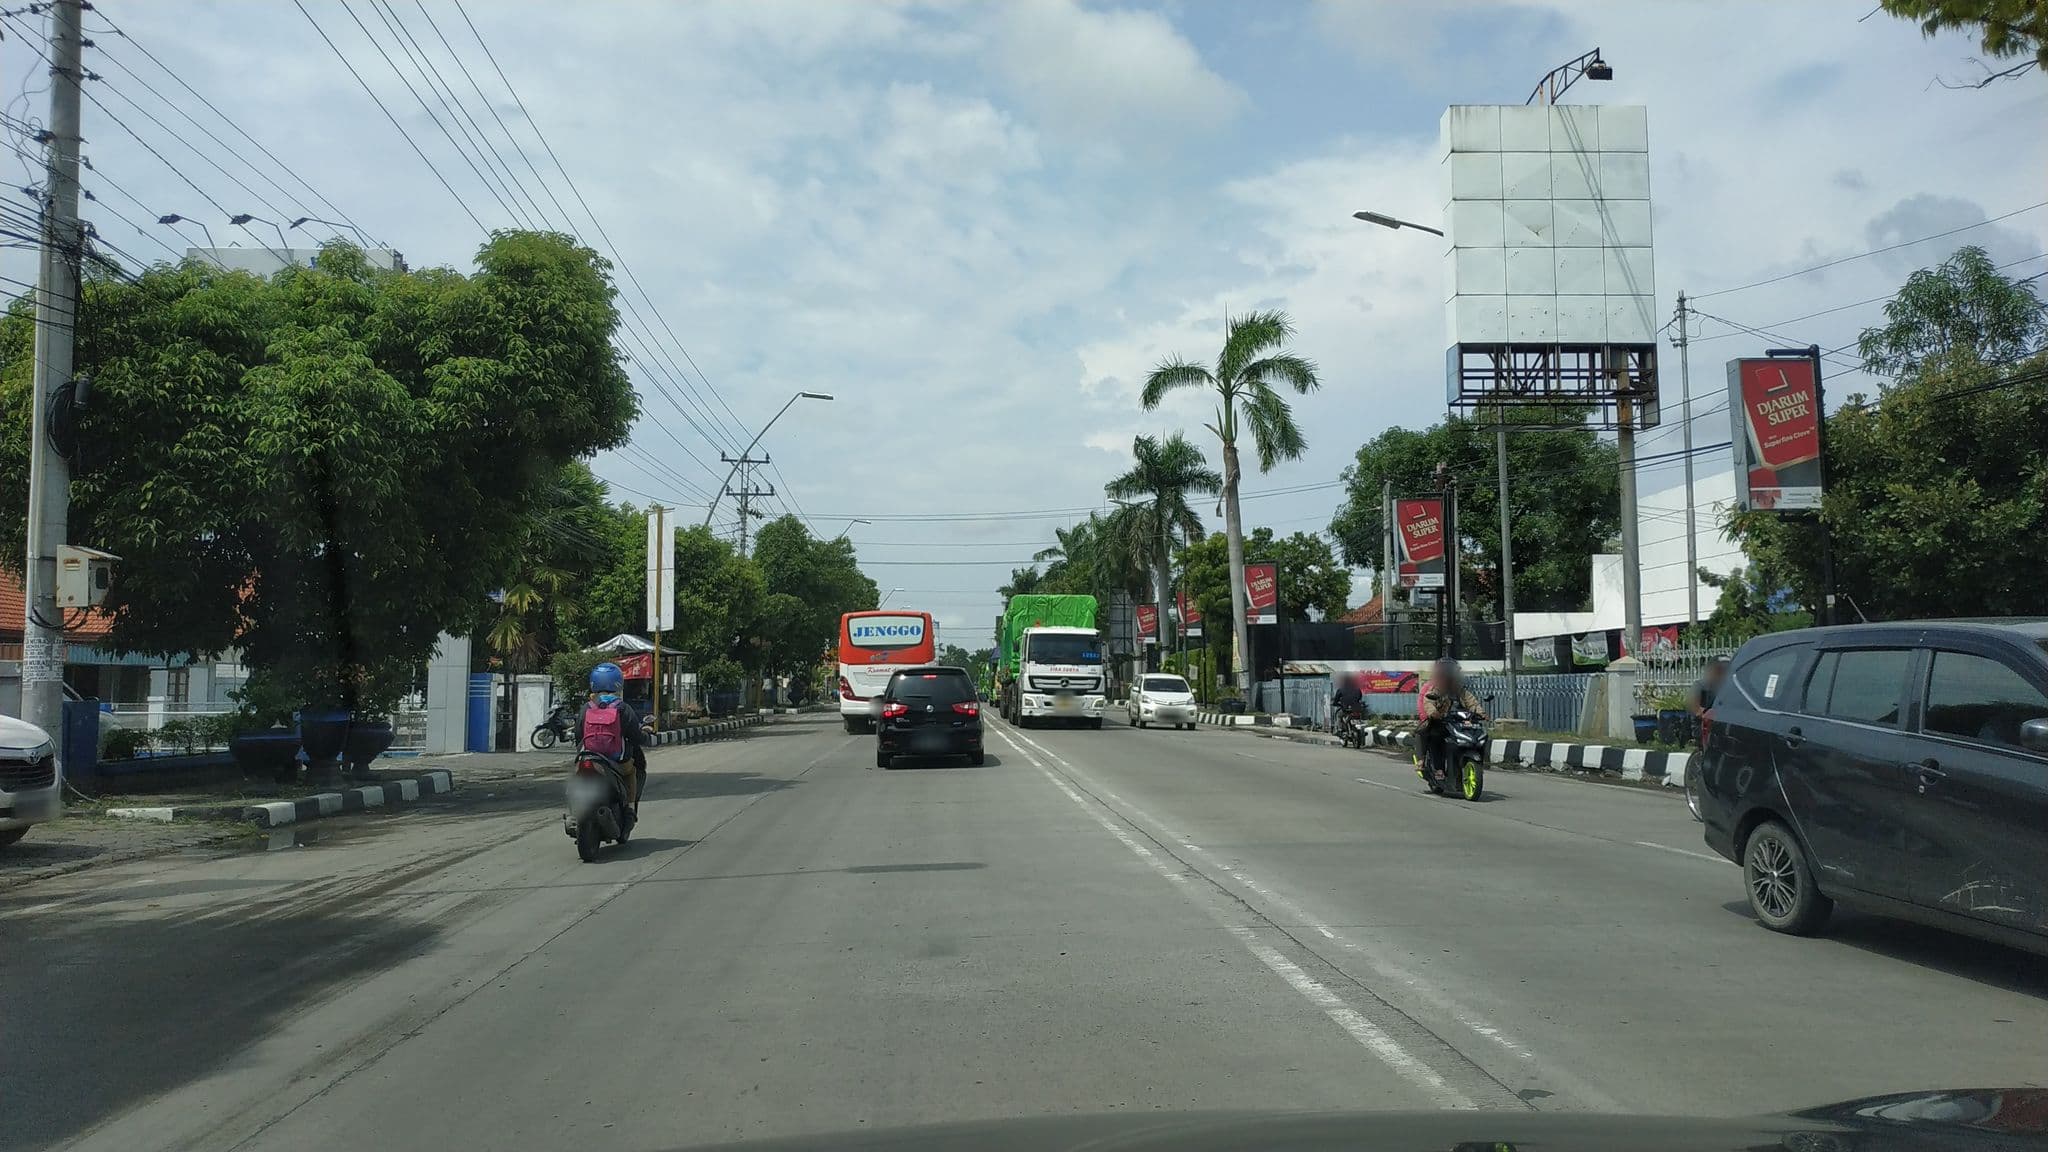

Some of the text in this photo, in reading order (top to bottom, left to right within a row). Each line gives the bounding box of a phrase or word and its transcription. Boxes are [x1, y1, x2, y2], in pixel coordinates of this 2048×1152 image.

[1756, 390, 1810, 417] DJARUM
[1768, 403, 1810, 426] SUPER
[1412, 525, 1439, 539] SUPER
[853, 625, 921, 638] JENGGO
